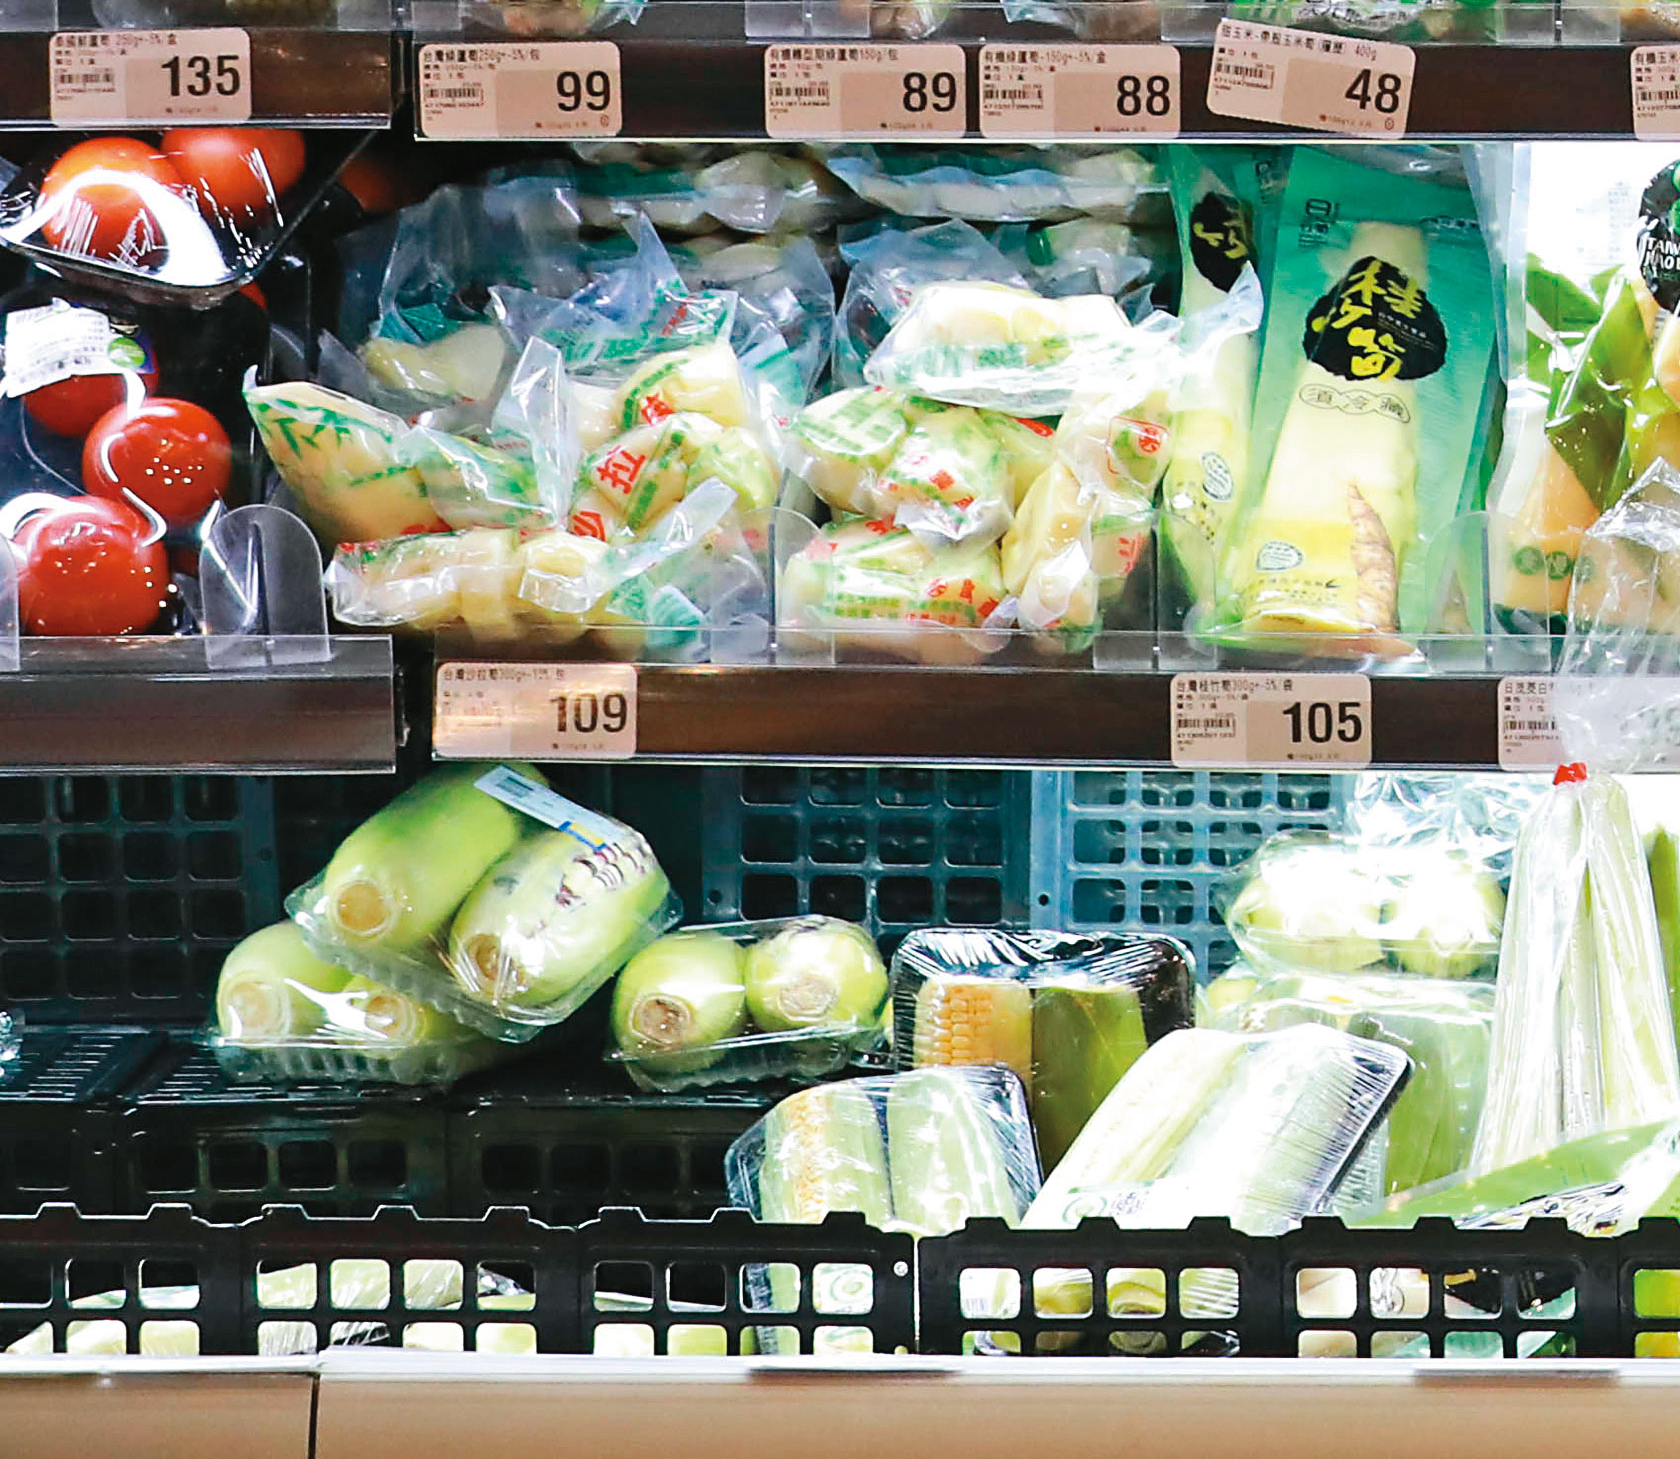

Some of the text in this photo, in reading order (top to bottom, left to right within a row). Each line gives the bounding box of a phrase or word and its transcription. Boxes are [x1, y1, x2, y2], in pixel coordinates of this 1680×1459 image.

[162, 56, 240, 96] 135
[557, 71, 610, 111] 99
[903, 73, 956, 112] 89
[1117, 76, 1170, 116] 88
[1345, 69, 1401, 113] 48
[549, 694, 626, 733] 109
[1283, 702, 1361, 743] 105
